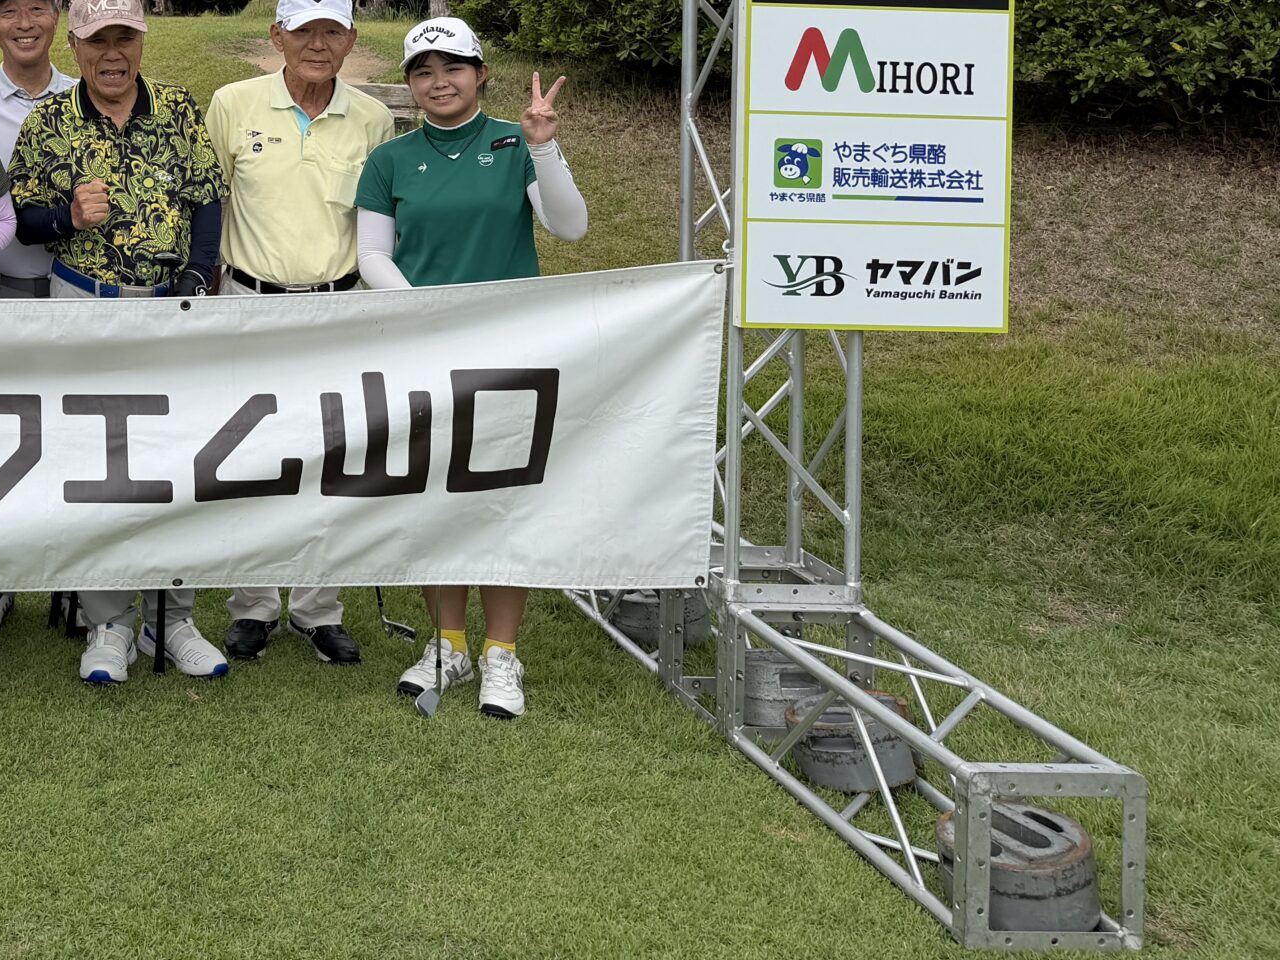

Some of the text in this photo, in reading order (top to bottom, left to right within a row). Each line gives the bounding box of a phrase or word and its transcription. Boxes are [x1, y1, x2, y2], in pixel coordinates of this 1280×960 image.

[412, 26, 456, 43] Callaway
[832, 141, 946, 165] やまぐち県酪
[832, 167, 984, 191] 販売輸送株式会社
[769, 192, 826, 203] やまぐち県酪
[773, 254, 846, 297] YB
[865, 258, 982, 287] ヤマバン
[865, 288, 982, 301] Yamaguchi Bankin
